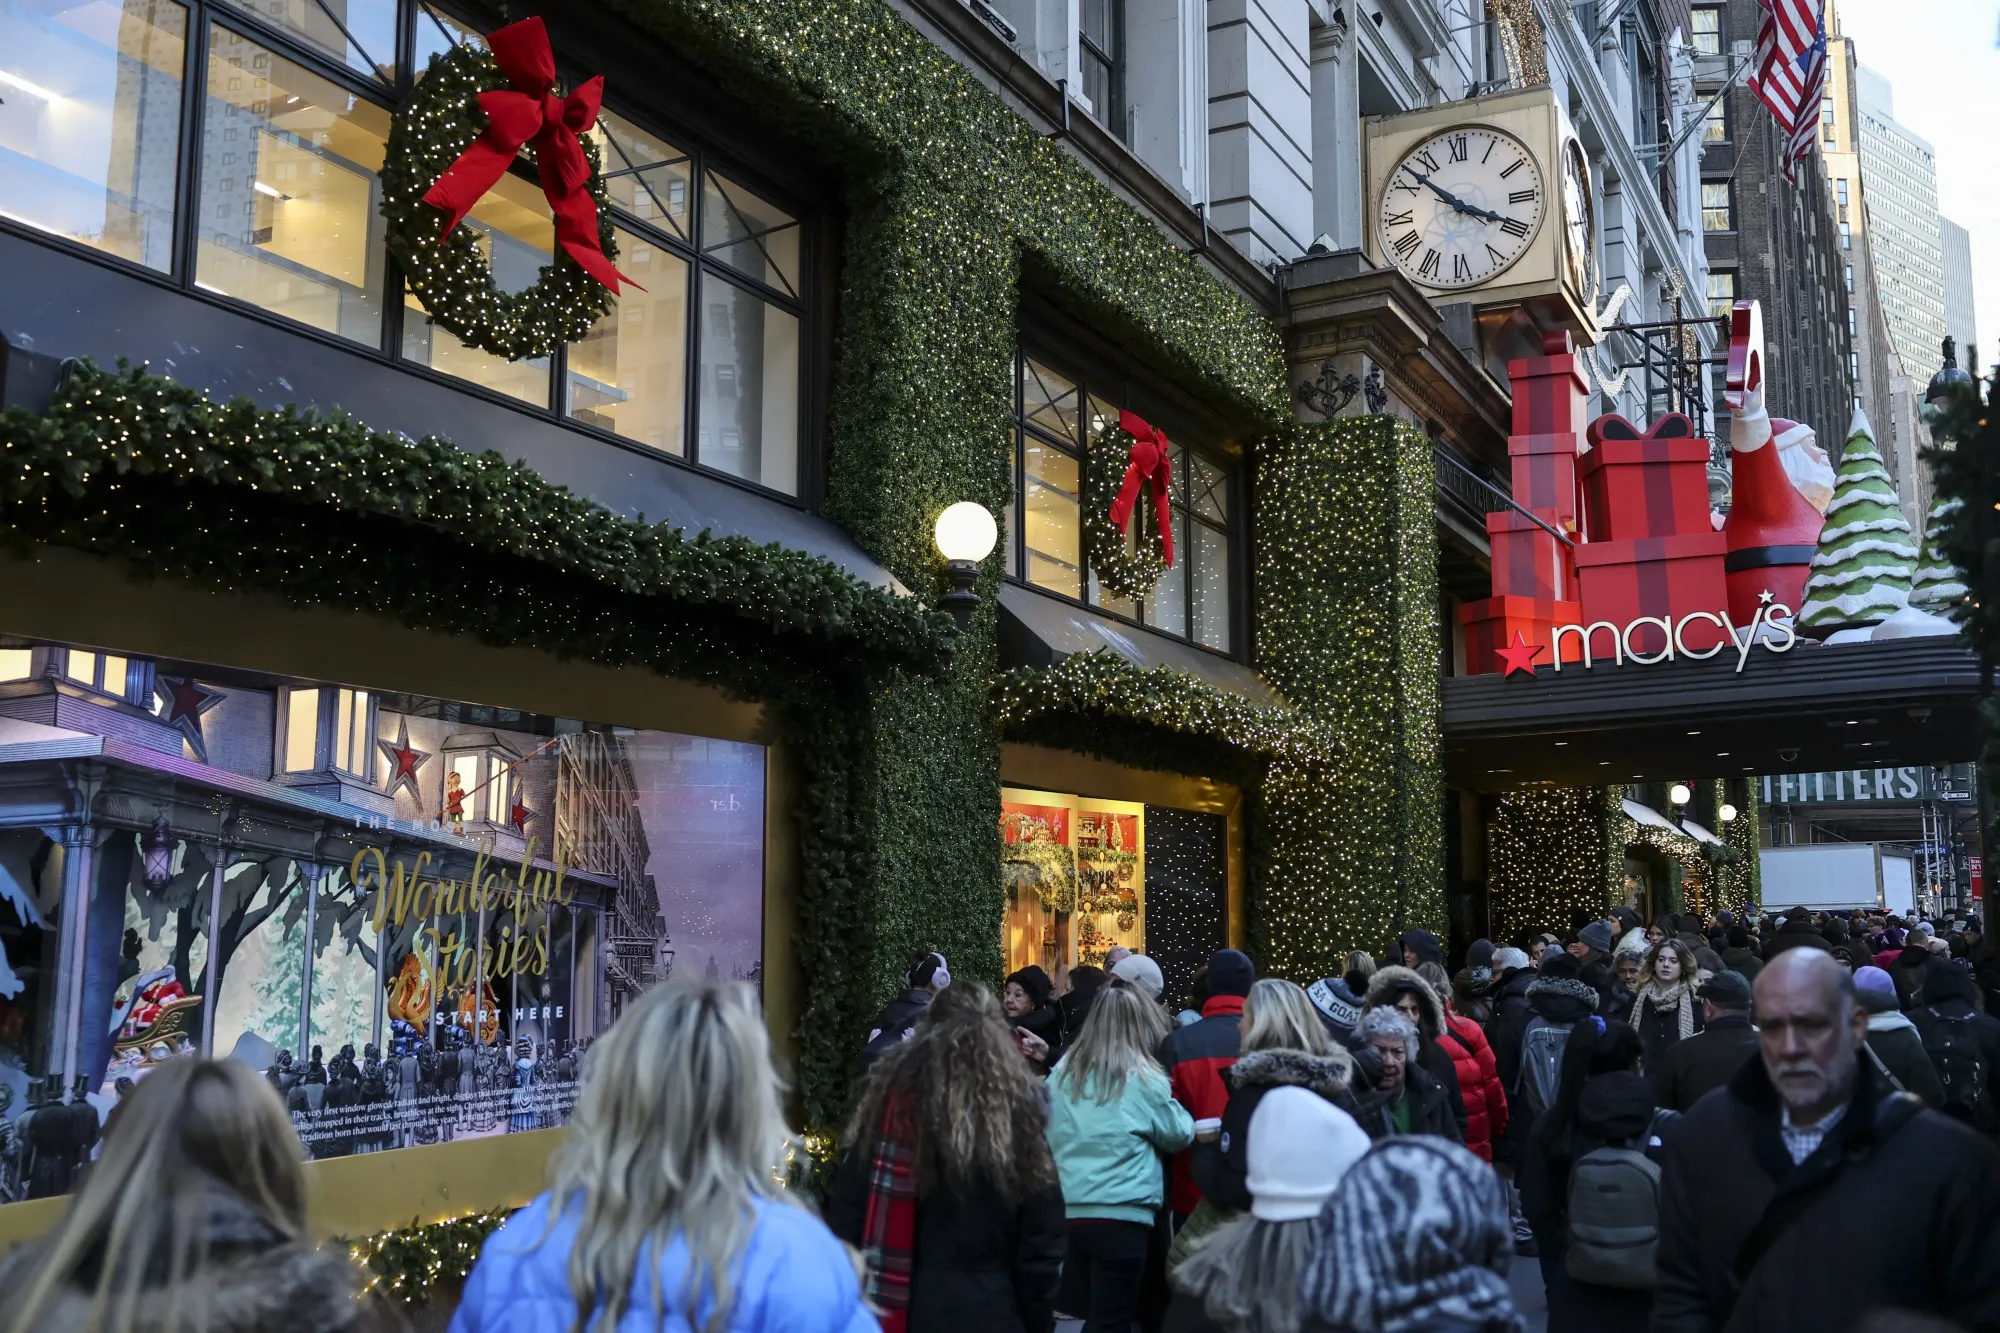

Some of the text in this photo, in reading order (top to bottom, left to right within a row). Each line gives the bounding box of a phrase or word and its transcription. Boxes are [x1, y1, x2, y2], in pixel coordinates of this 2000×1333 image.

[1416, 151, 1440, 177] XI
[1448, 137, 1468, 164] XII
[1395, 179, 1420, 197] X
[354, 814, 469, 835] THE MOST
[1914, 847, 1924, 855] est
[350, 829, 579, 934] Wonderful
[390, 925, 548, 1021] Stories
[435, 1006, 564, 1026] START HERE
[292, 1109, 307, 1119] The
[307, 1108, 322, 1119] very
[324, 1106, 338, 1116] first
[339, 1103, 366, 1114] window
[394, 1098, 417, 1108] radiant
[418, 1096, 430, 1105] and
[557, 1080, 574, 1089] winter
[292, 1121, 313, 1131] milies
[314, 1117, 344, 1129] stopped
[345, 1116, 352, 1125] in
[353, 1114, 370, 1123] their
[394, 1108, 426, 1119] breathless
[434, 1105, 445, 1113] the
[464, 1100, 493, 1110] Christmas
[302, 1130, 333, 1142] tradition
[334, 1128, 352, 1138] born
[352, 1126, 366, 1135] that
[367, 1122, 389, 1133] would
[389, 1121, 401, 1131] last
[402, 1119, 428, 1129] through
[429, 1117, 439, 1125] the
[494, 1109, 506, 1117] and
